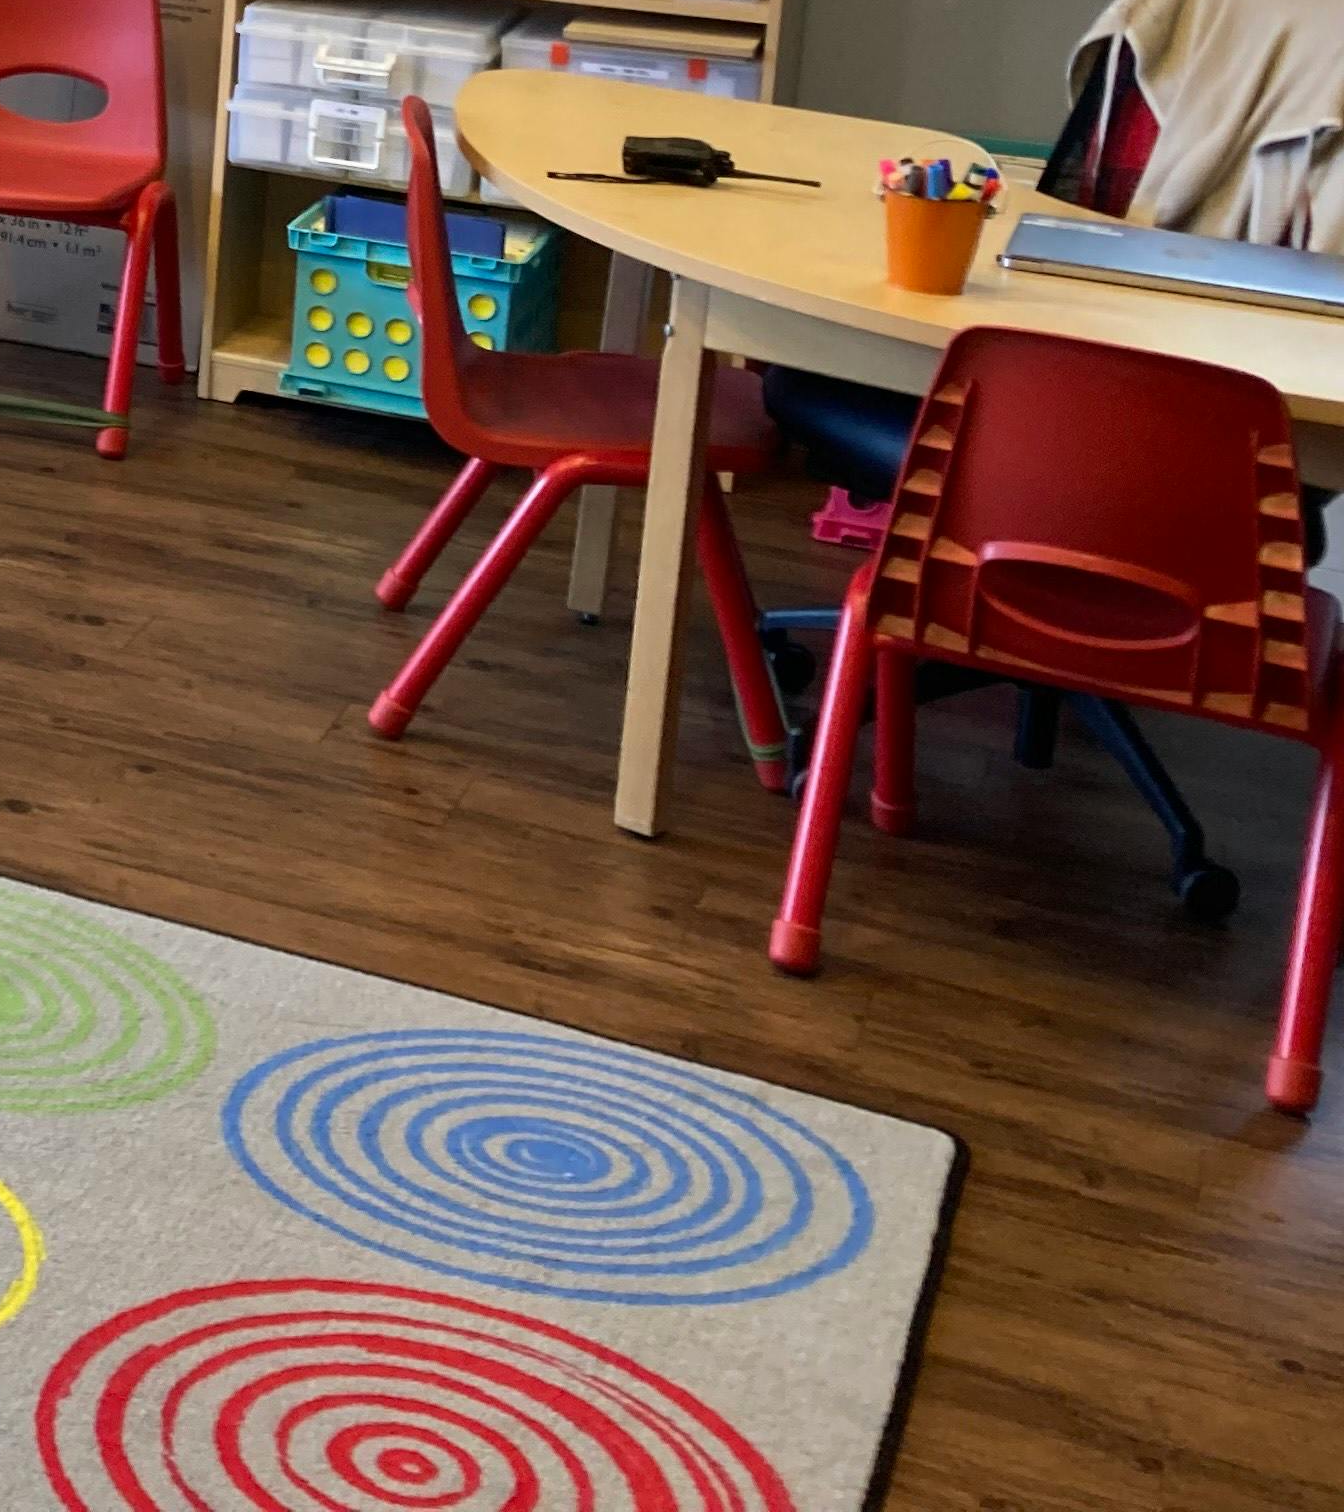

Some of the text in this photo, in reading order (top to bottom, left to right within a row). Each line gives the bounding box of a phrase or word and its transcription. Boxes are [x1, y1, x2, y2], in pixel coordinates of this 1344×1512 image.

[11, 216, 25, 227] 36
[0, 231, 25, 244] 91.4
[27, 238, 48, 248] cm
